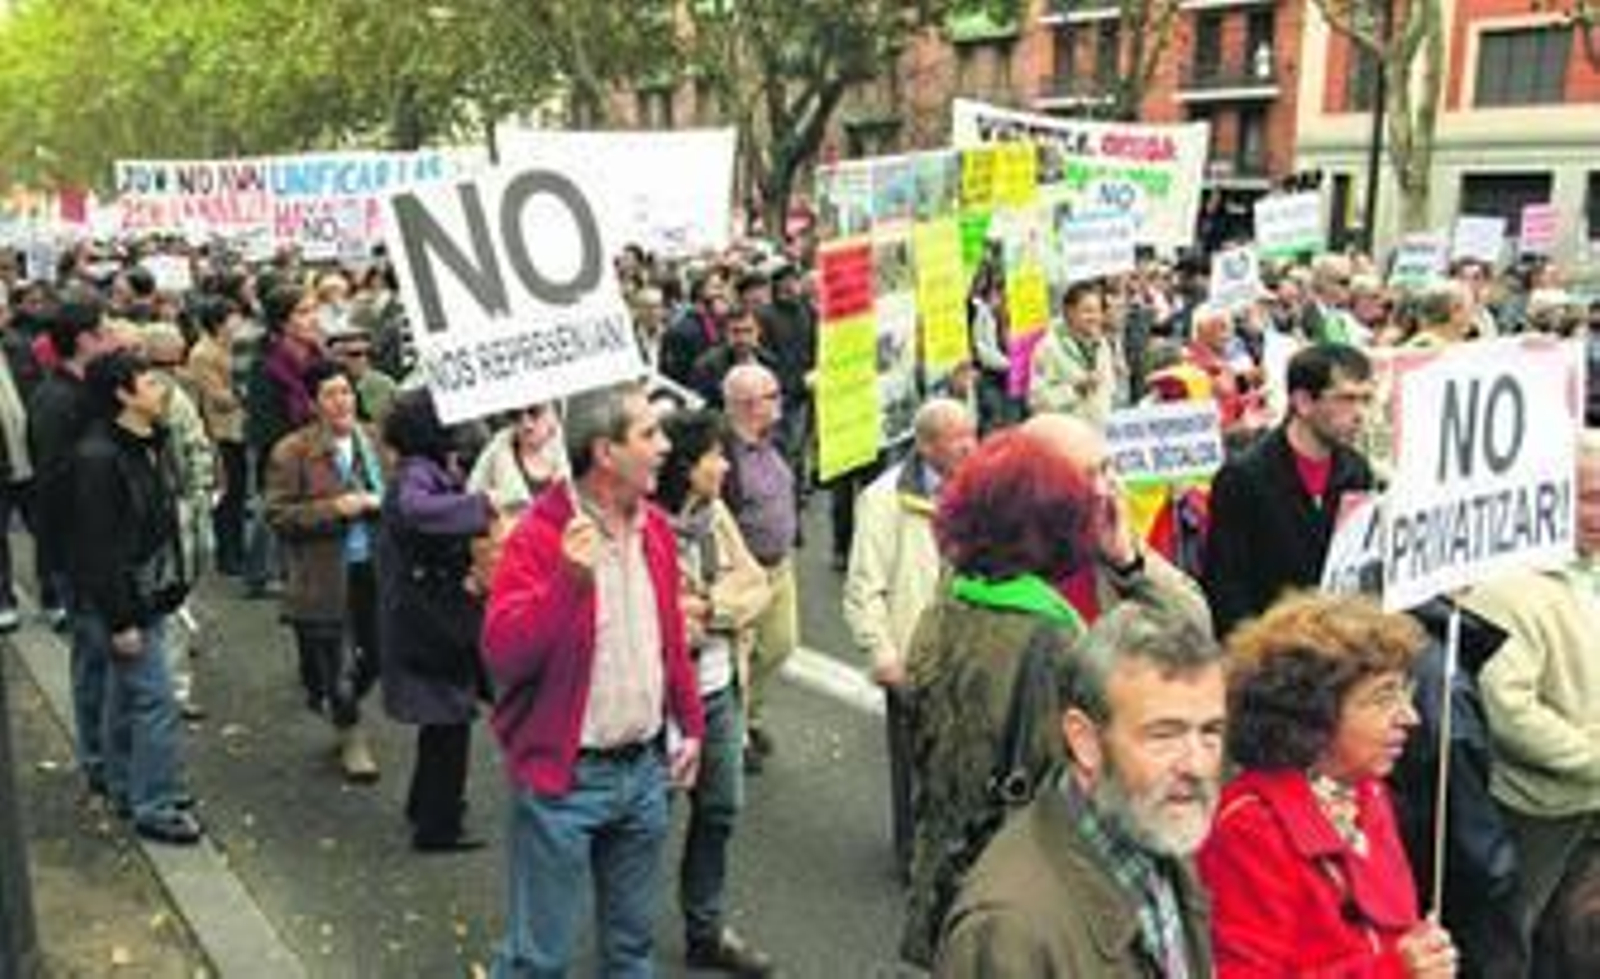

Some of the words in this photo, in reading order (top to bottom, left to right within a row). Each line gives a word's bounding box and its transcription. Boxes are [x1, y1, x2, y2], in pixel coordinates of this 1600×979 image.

[391, 169, 604, 333] NO
[1438, 374, 1526, 483] NO
[1387, 477, 1571, 584] PRIVATIZAR!
